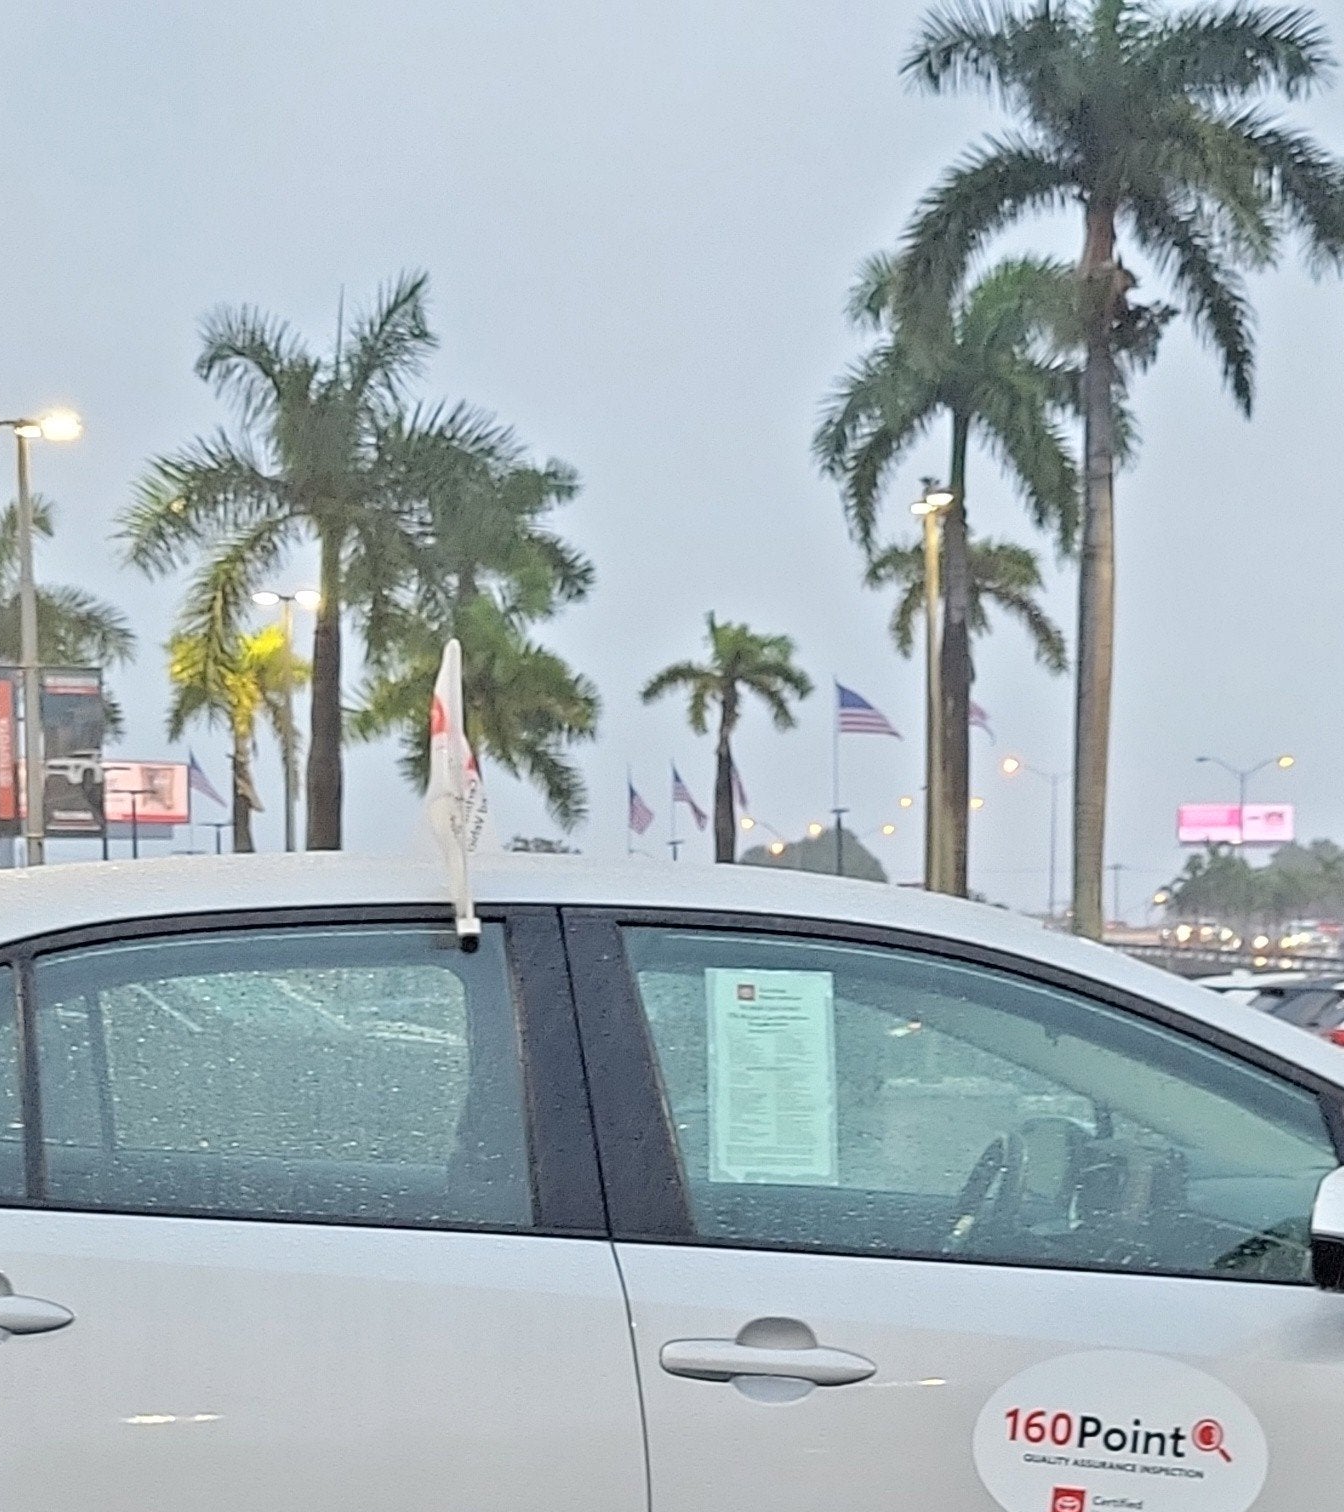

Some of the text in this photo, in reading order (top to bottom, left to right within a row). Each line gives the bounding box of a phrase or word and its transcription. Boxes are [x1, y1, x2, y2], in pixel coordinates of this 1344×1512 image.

[1022, 1453, 1205, 1480] QUALITY ASSURANCE INSPECTION
[1092, 1496, 1144, 1511] Certified
